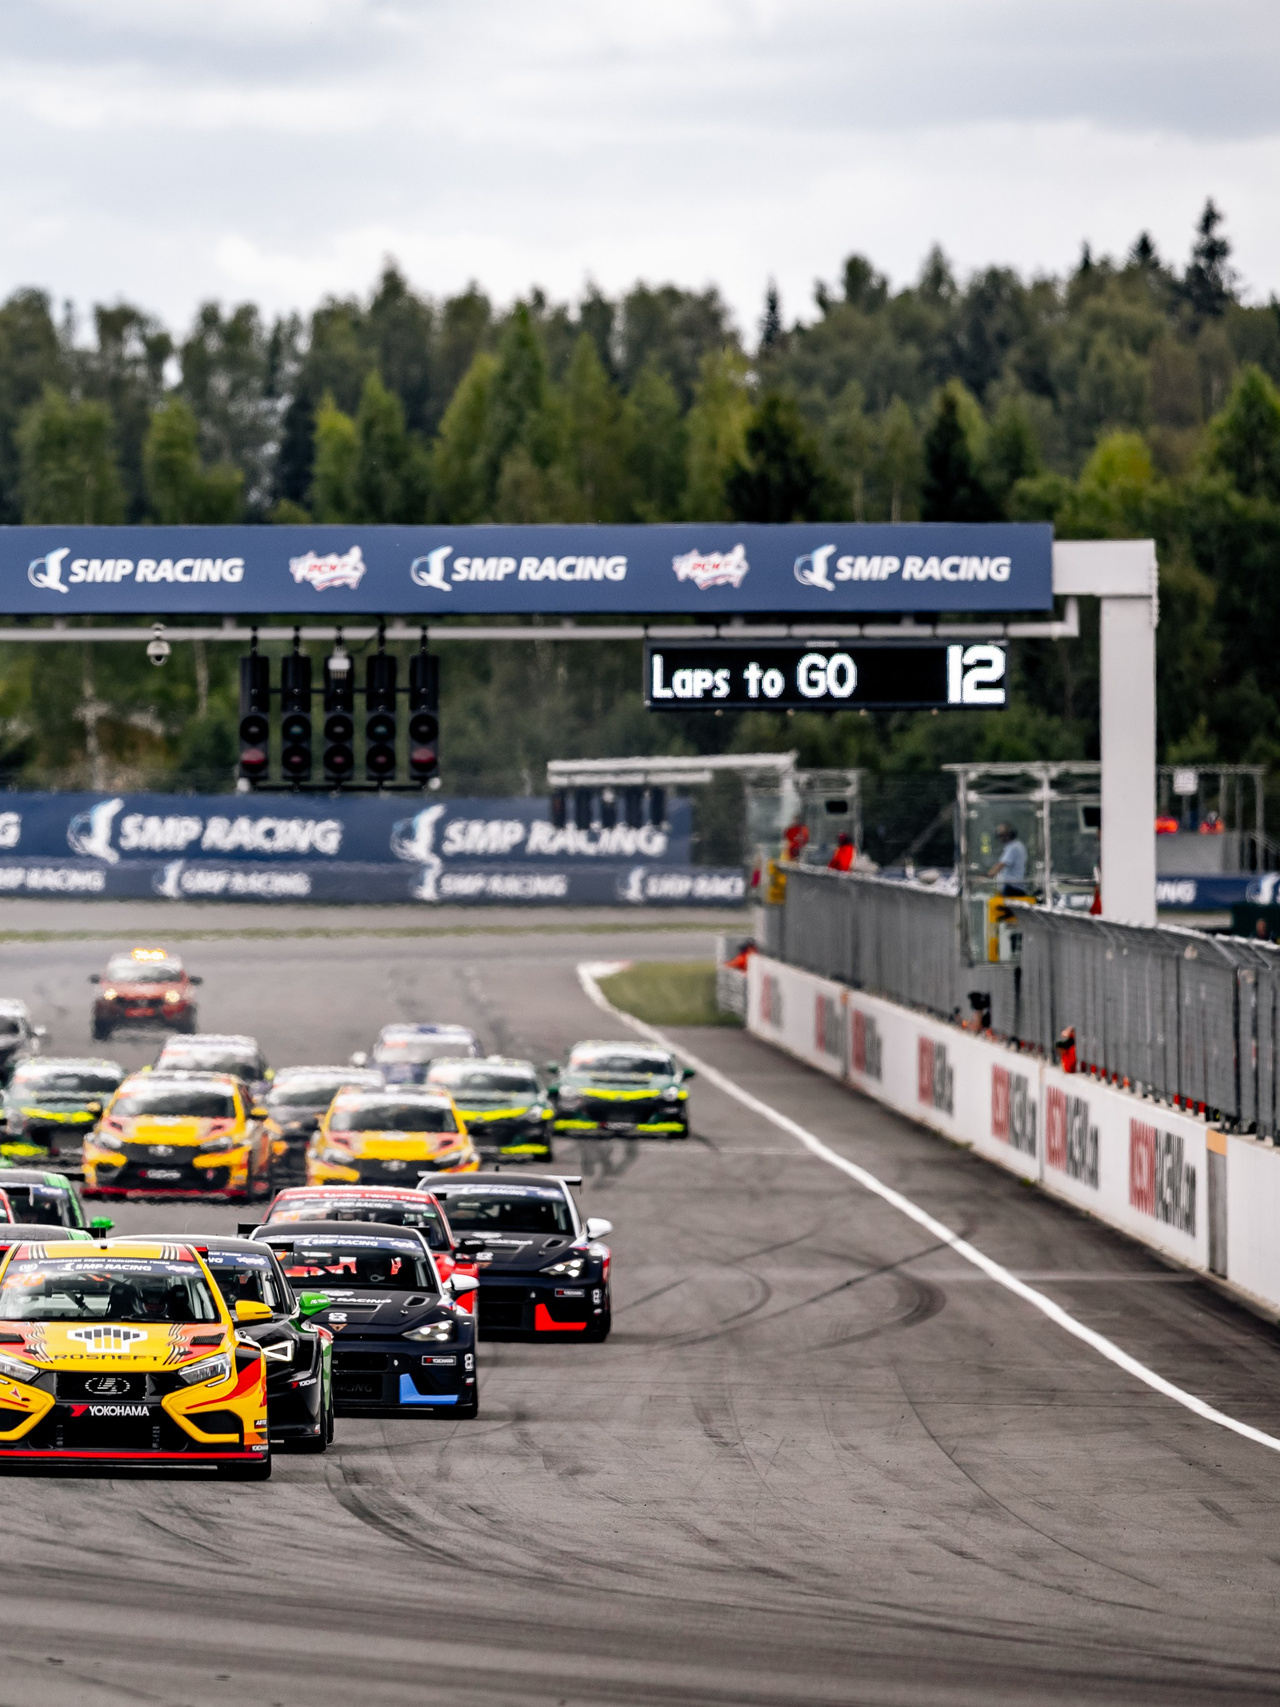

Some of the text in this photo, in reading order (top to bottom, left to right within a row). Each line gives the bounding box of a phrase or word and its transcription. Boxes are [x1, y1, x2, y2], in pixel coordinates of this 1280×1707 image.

[68, 557, 244, 582] SMP RACING
[451, 556, 627, 581] SMP RACING
[834, 556, 1011, 580] SMP RACING
[652, 644, 1006, 704] Laps to GO 12
[120, 813, 342, 856] SMP RACING
[442, 817, 668, 858] SMP RACING
[692, 874, 744, 898] RACI
[312, 1238, 336, 1246] SMP
[337, 1239, 378, 1247] RACING
[99, 1263, 144, 1271] RACING
[89, 1405, 150, 1417] YOKOHAMA
